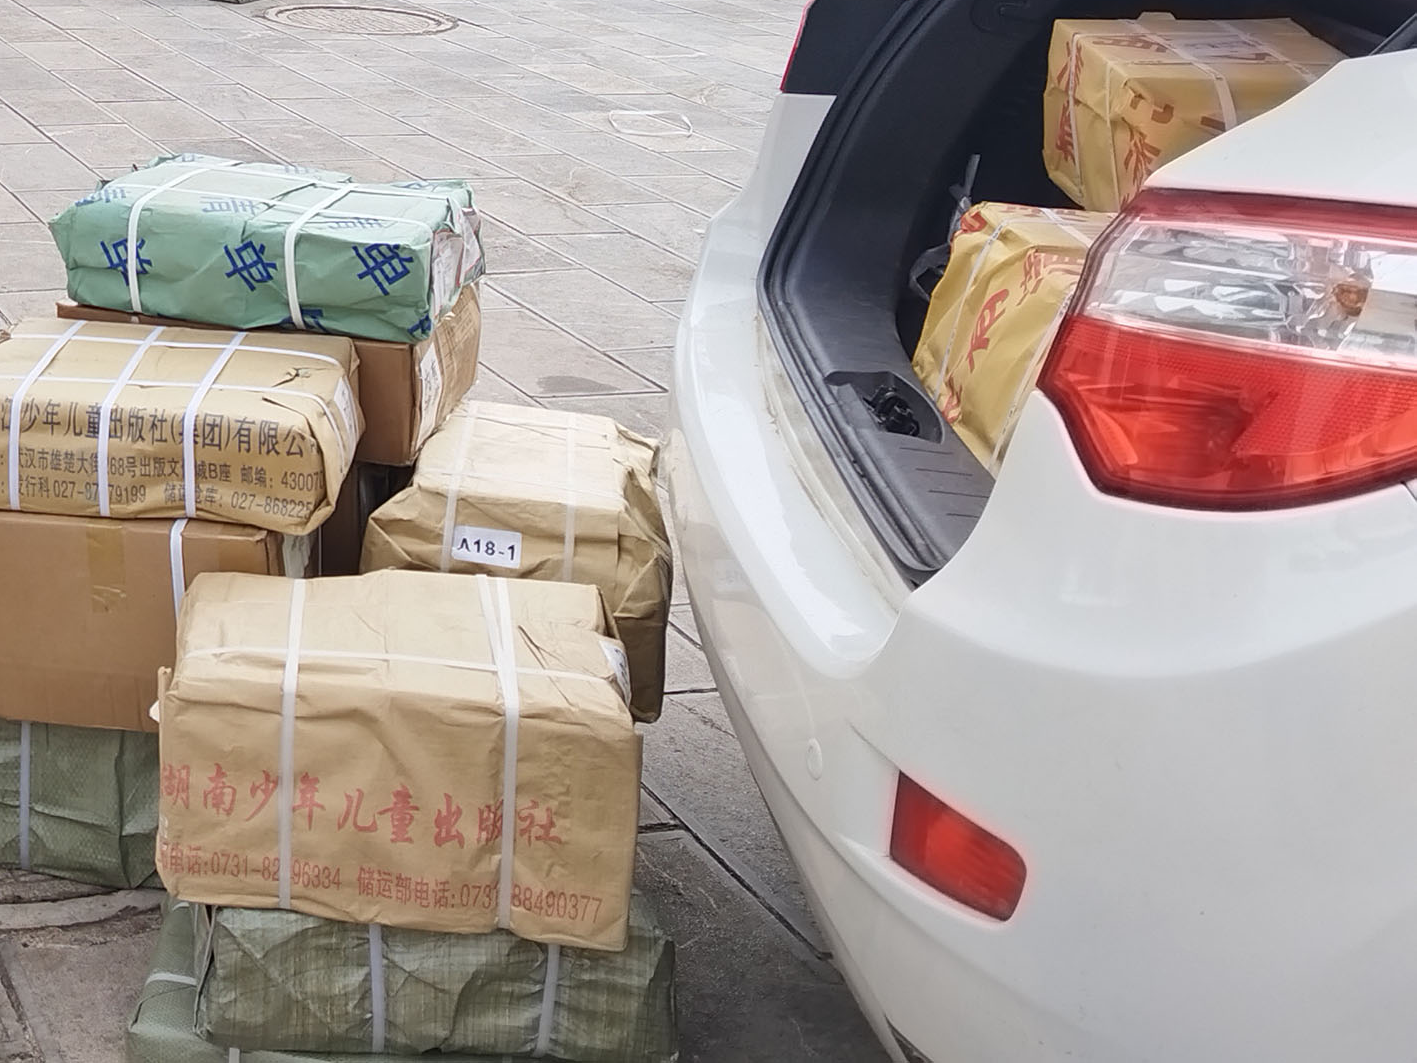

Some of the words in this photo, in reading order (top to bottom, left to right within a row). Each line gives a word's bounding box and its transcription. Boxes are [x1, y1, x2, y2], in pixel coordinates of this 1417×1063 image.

[53, 480, 147, 505] 027-8779199
[457, 537, 516, 561] A18-1
[161, 762, 563, 849] 湖南少年儿童出版社
